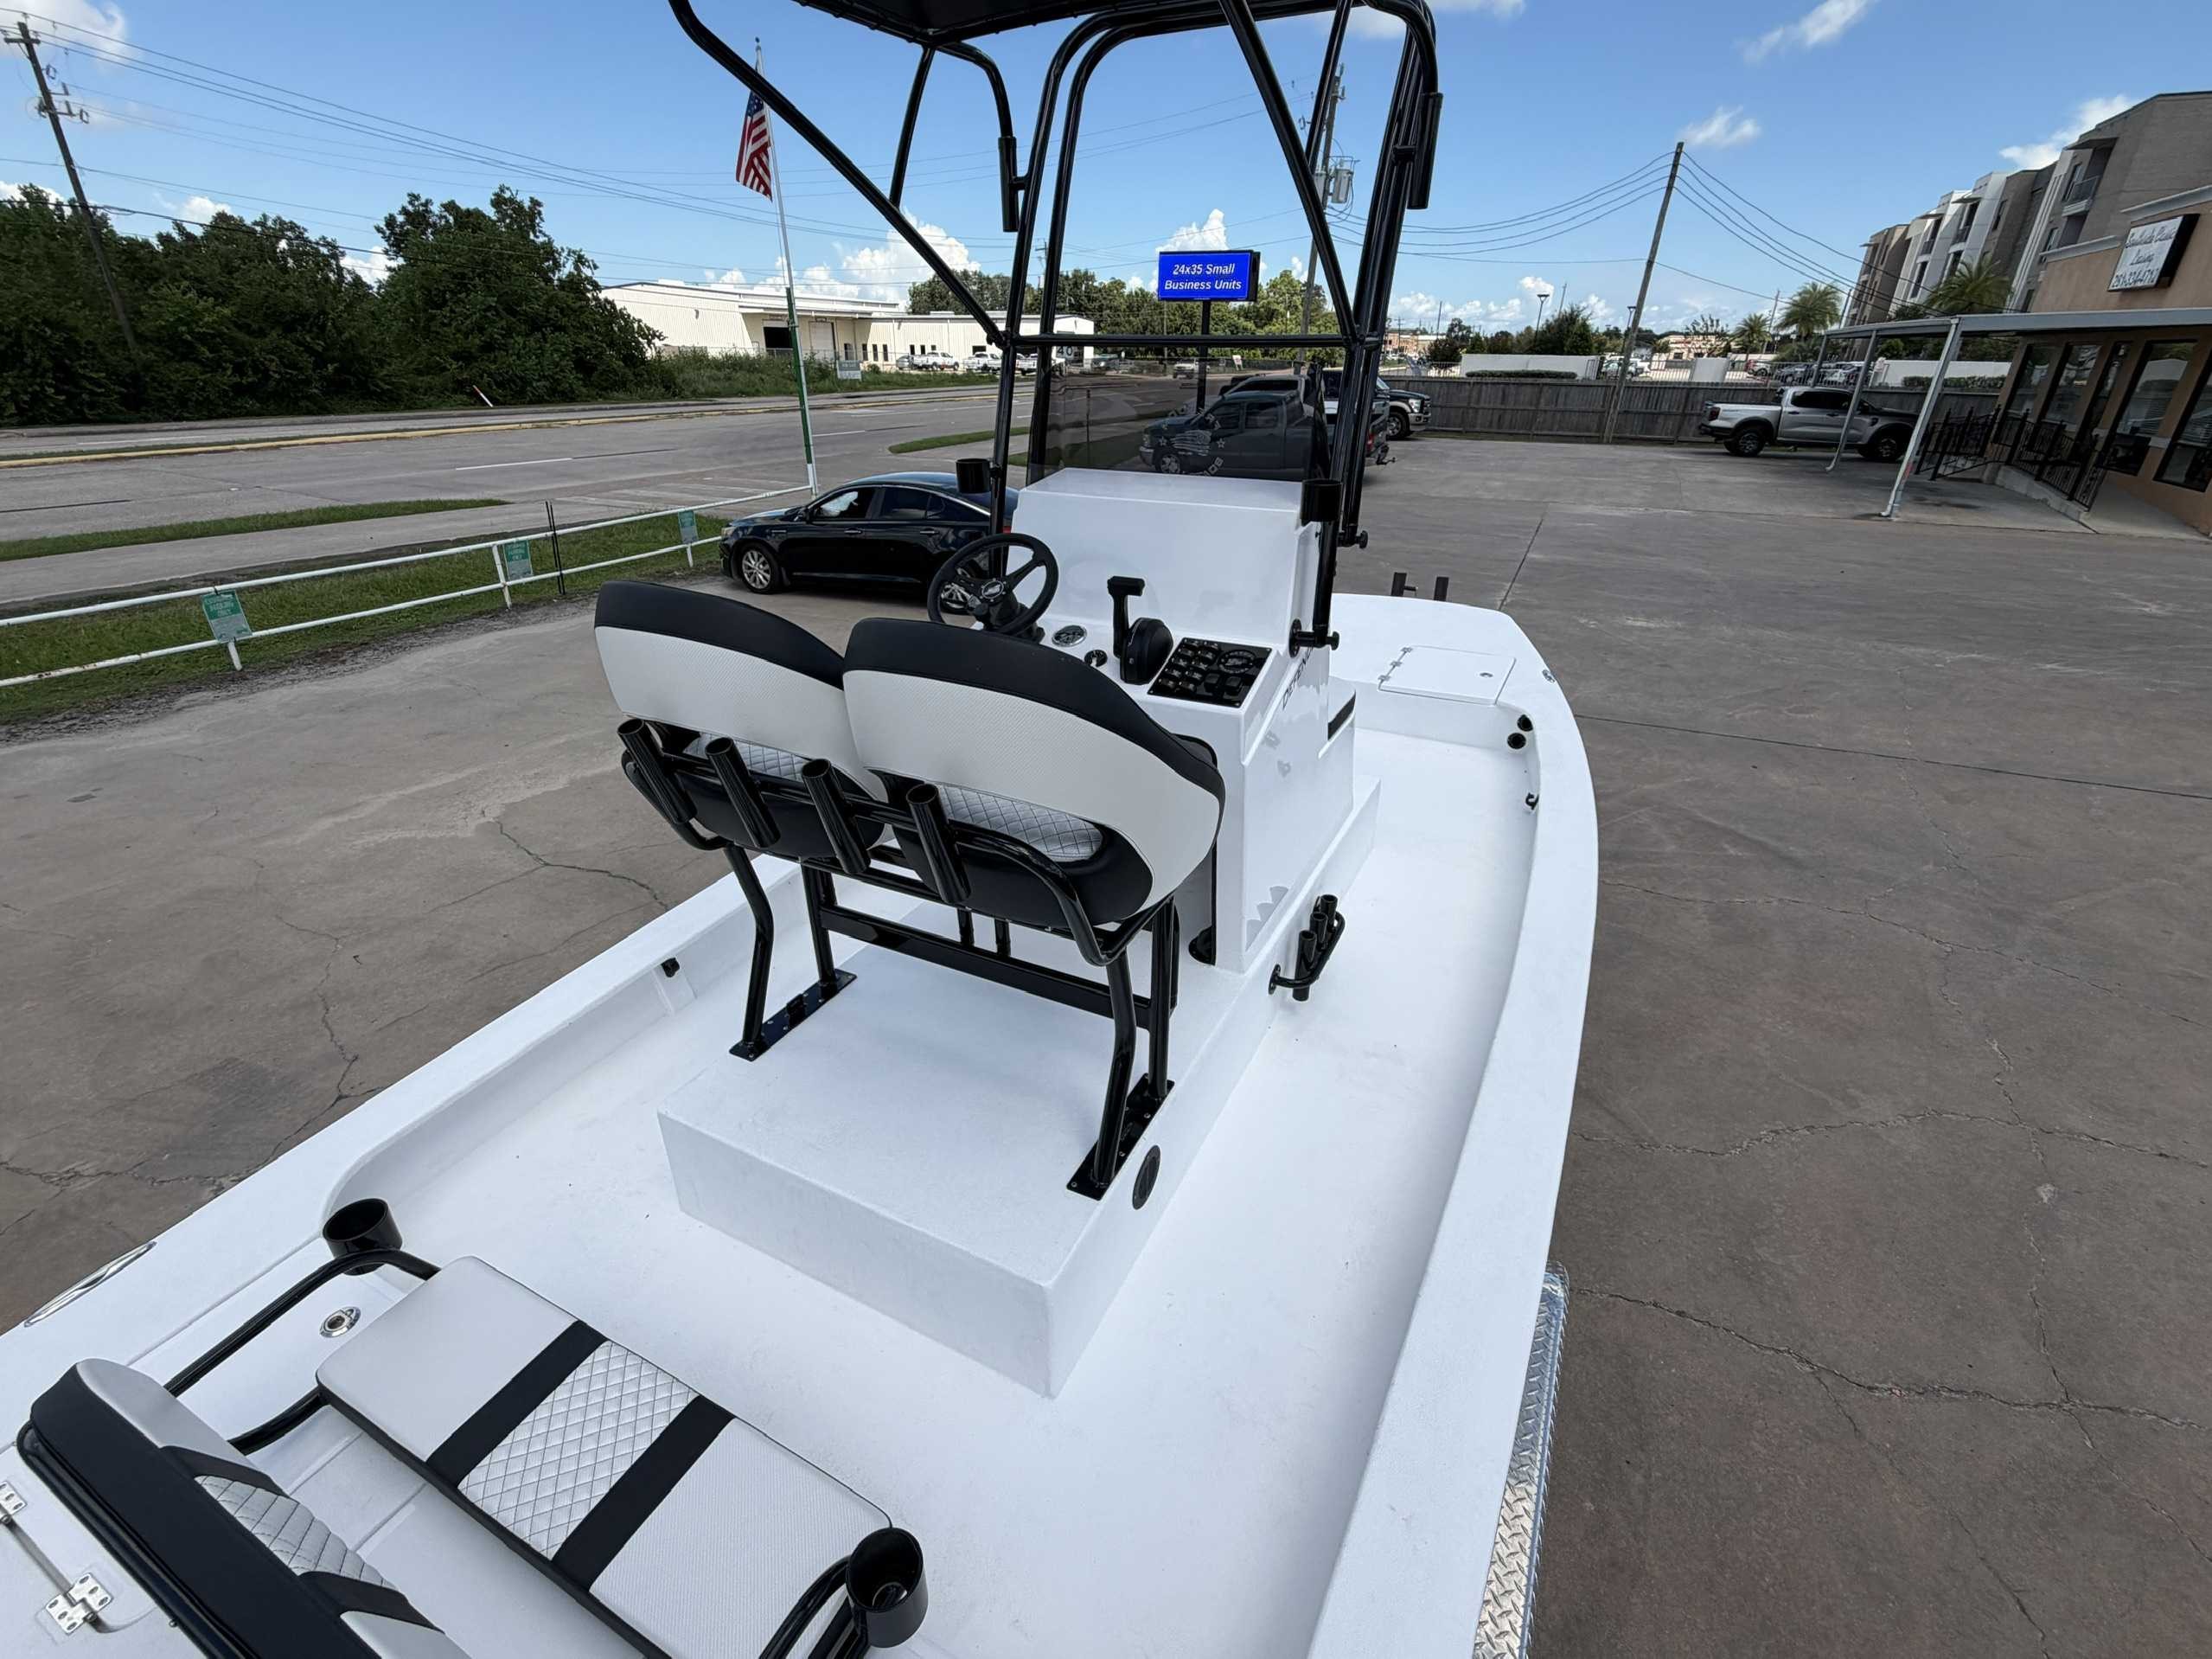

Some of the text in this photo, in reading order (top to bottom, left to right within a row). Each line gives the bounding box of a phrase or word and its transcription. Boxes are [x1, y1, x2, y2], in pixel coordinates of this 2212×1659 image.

[1173, 263, 1235, 275] 24x35 Small
[1164, 279, 1242, 290] Business Units
